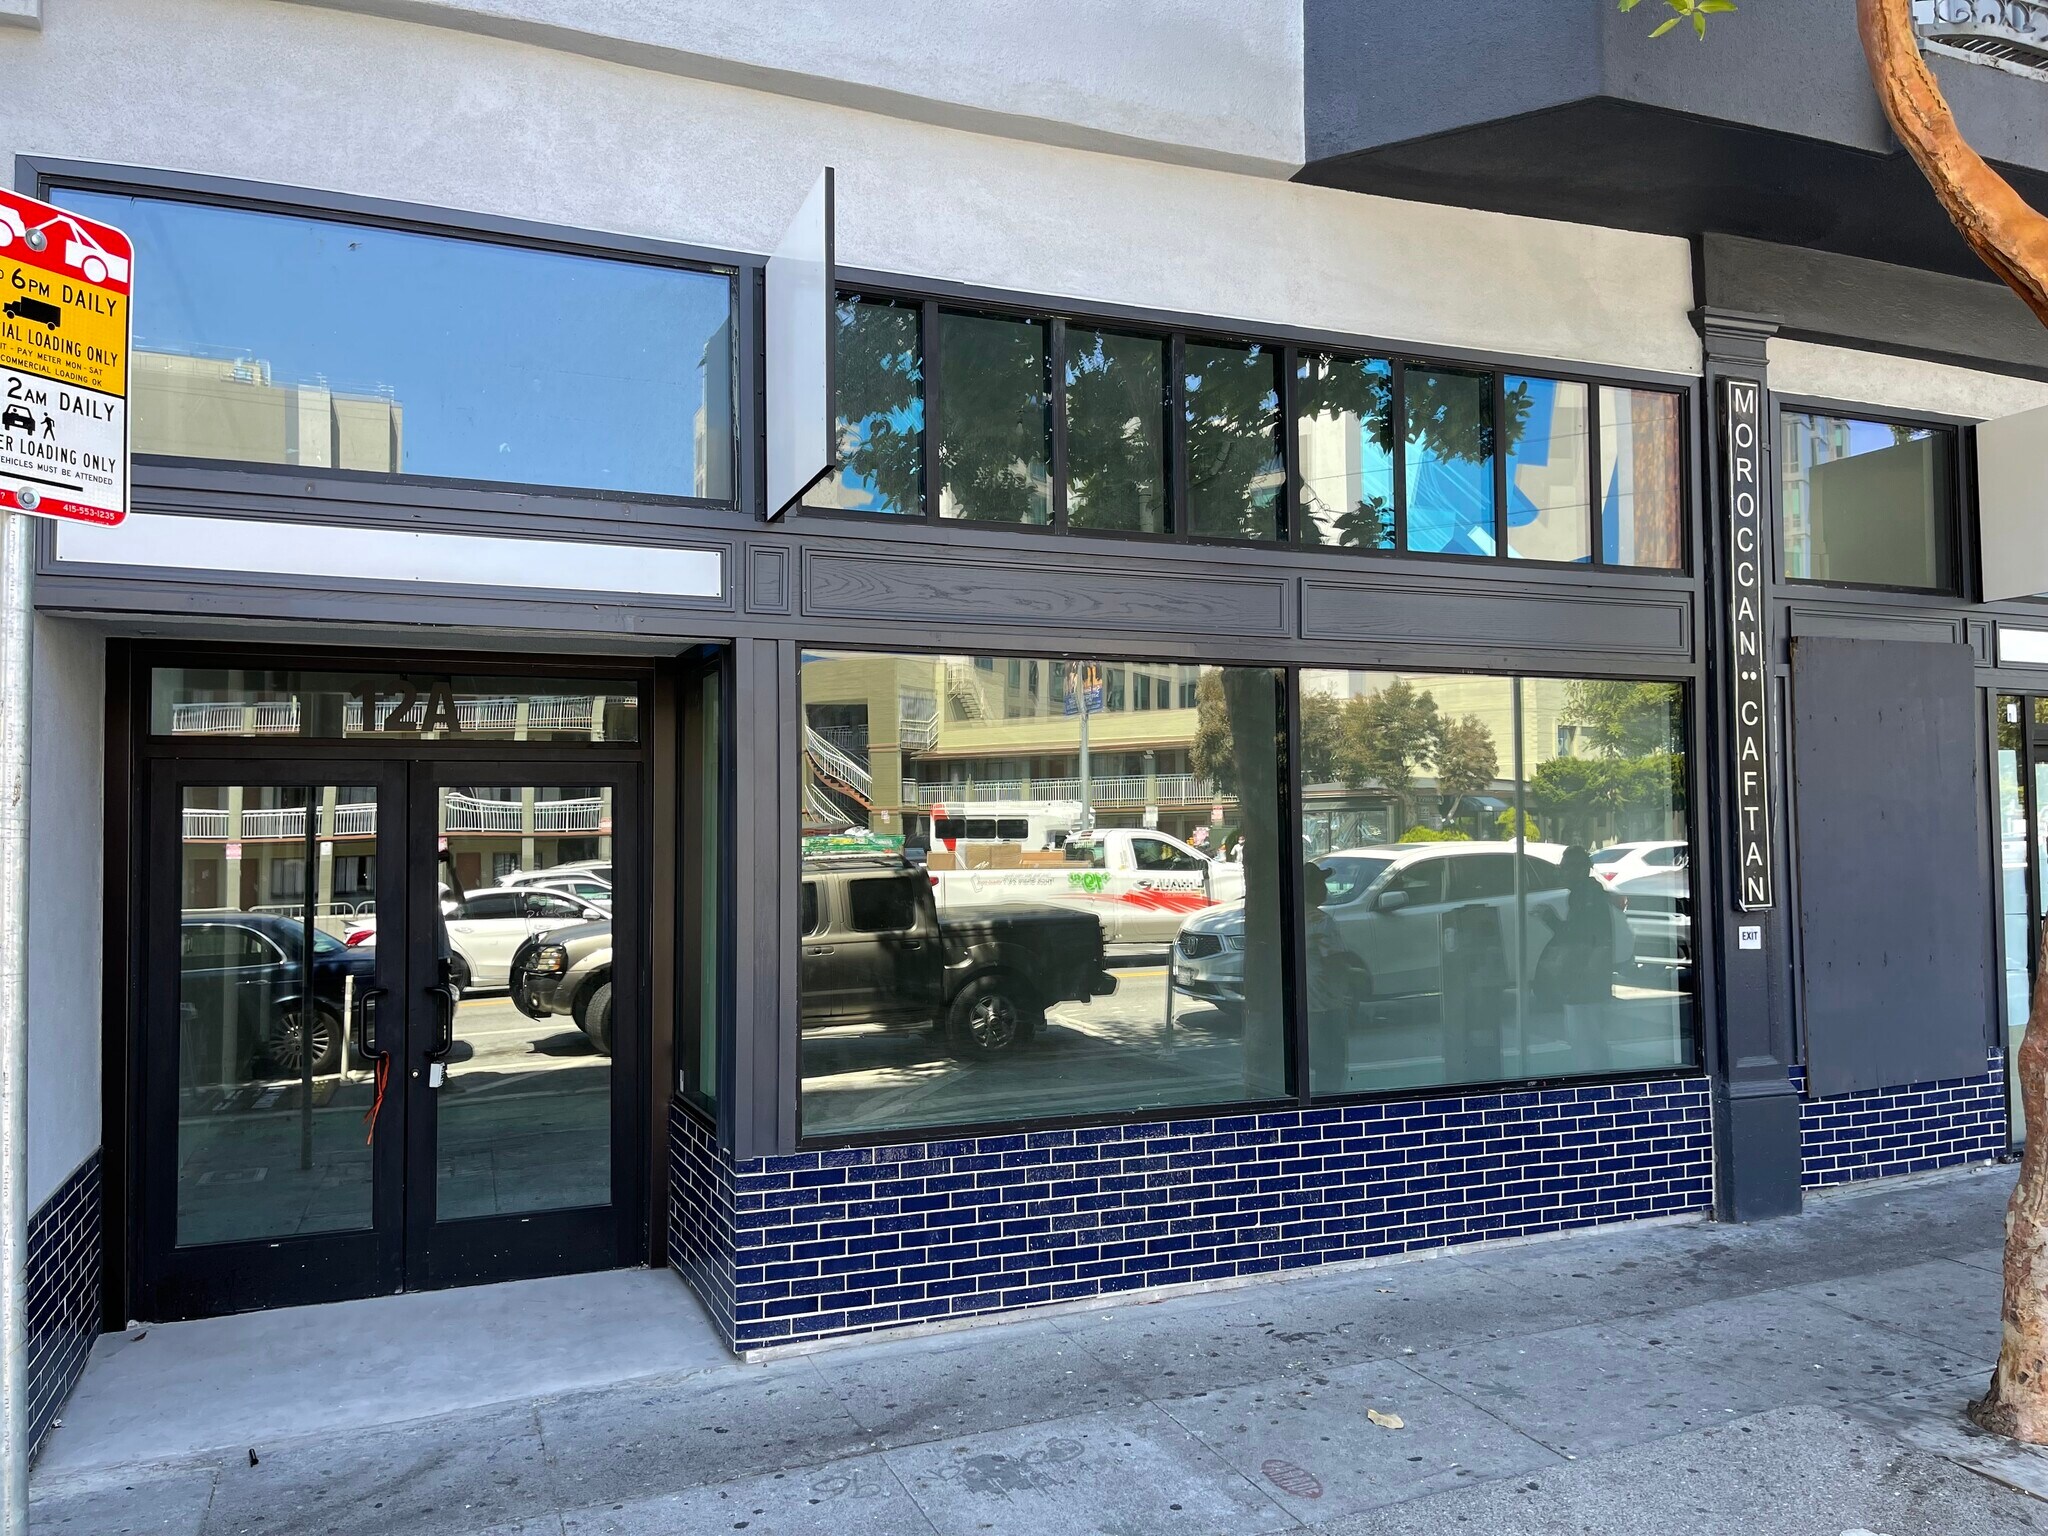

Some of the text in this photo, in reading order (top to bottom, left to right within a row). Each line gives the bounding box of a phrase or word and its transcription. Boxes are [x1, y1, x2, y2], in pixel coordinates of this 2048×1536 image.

[11, 267, 50, 298] 6PM
[62, 284, 117, 317] DAILY
[1, 321, 118, 368] IAL LOADING ONLY
[17, 346, 33, 357] PAY
[37, 352, 62, 365] METER
[65, 360, 82, 370] MON
[89, 366, 103, 376] SAT
[0, 354, 102, 387] COMMERCIAL LOADING OK
[7, 376, 115, 422] 2AM DAILY
[20, 438, 77, 465] LOADING
[83, 453, 116, 474] ONLY
[37, 463, 57, 474] MUST
[61, 468, 71, 477] BE
[74, 472, 113, 486] ATTENDED
[63, 503, 115, 520] 415-553-1235
[1734, 388, 1757, 657] MOROCCAN
[349, 680, 462, 732] 12A
[1740, 700, 1766, 902] CAFTAN
[1742, 931, 1758, 941] EXIT
